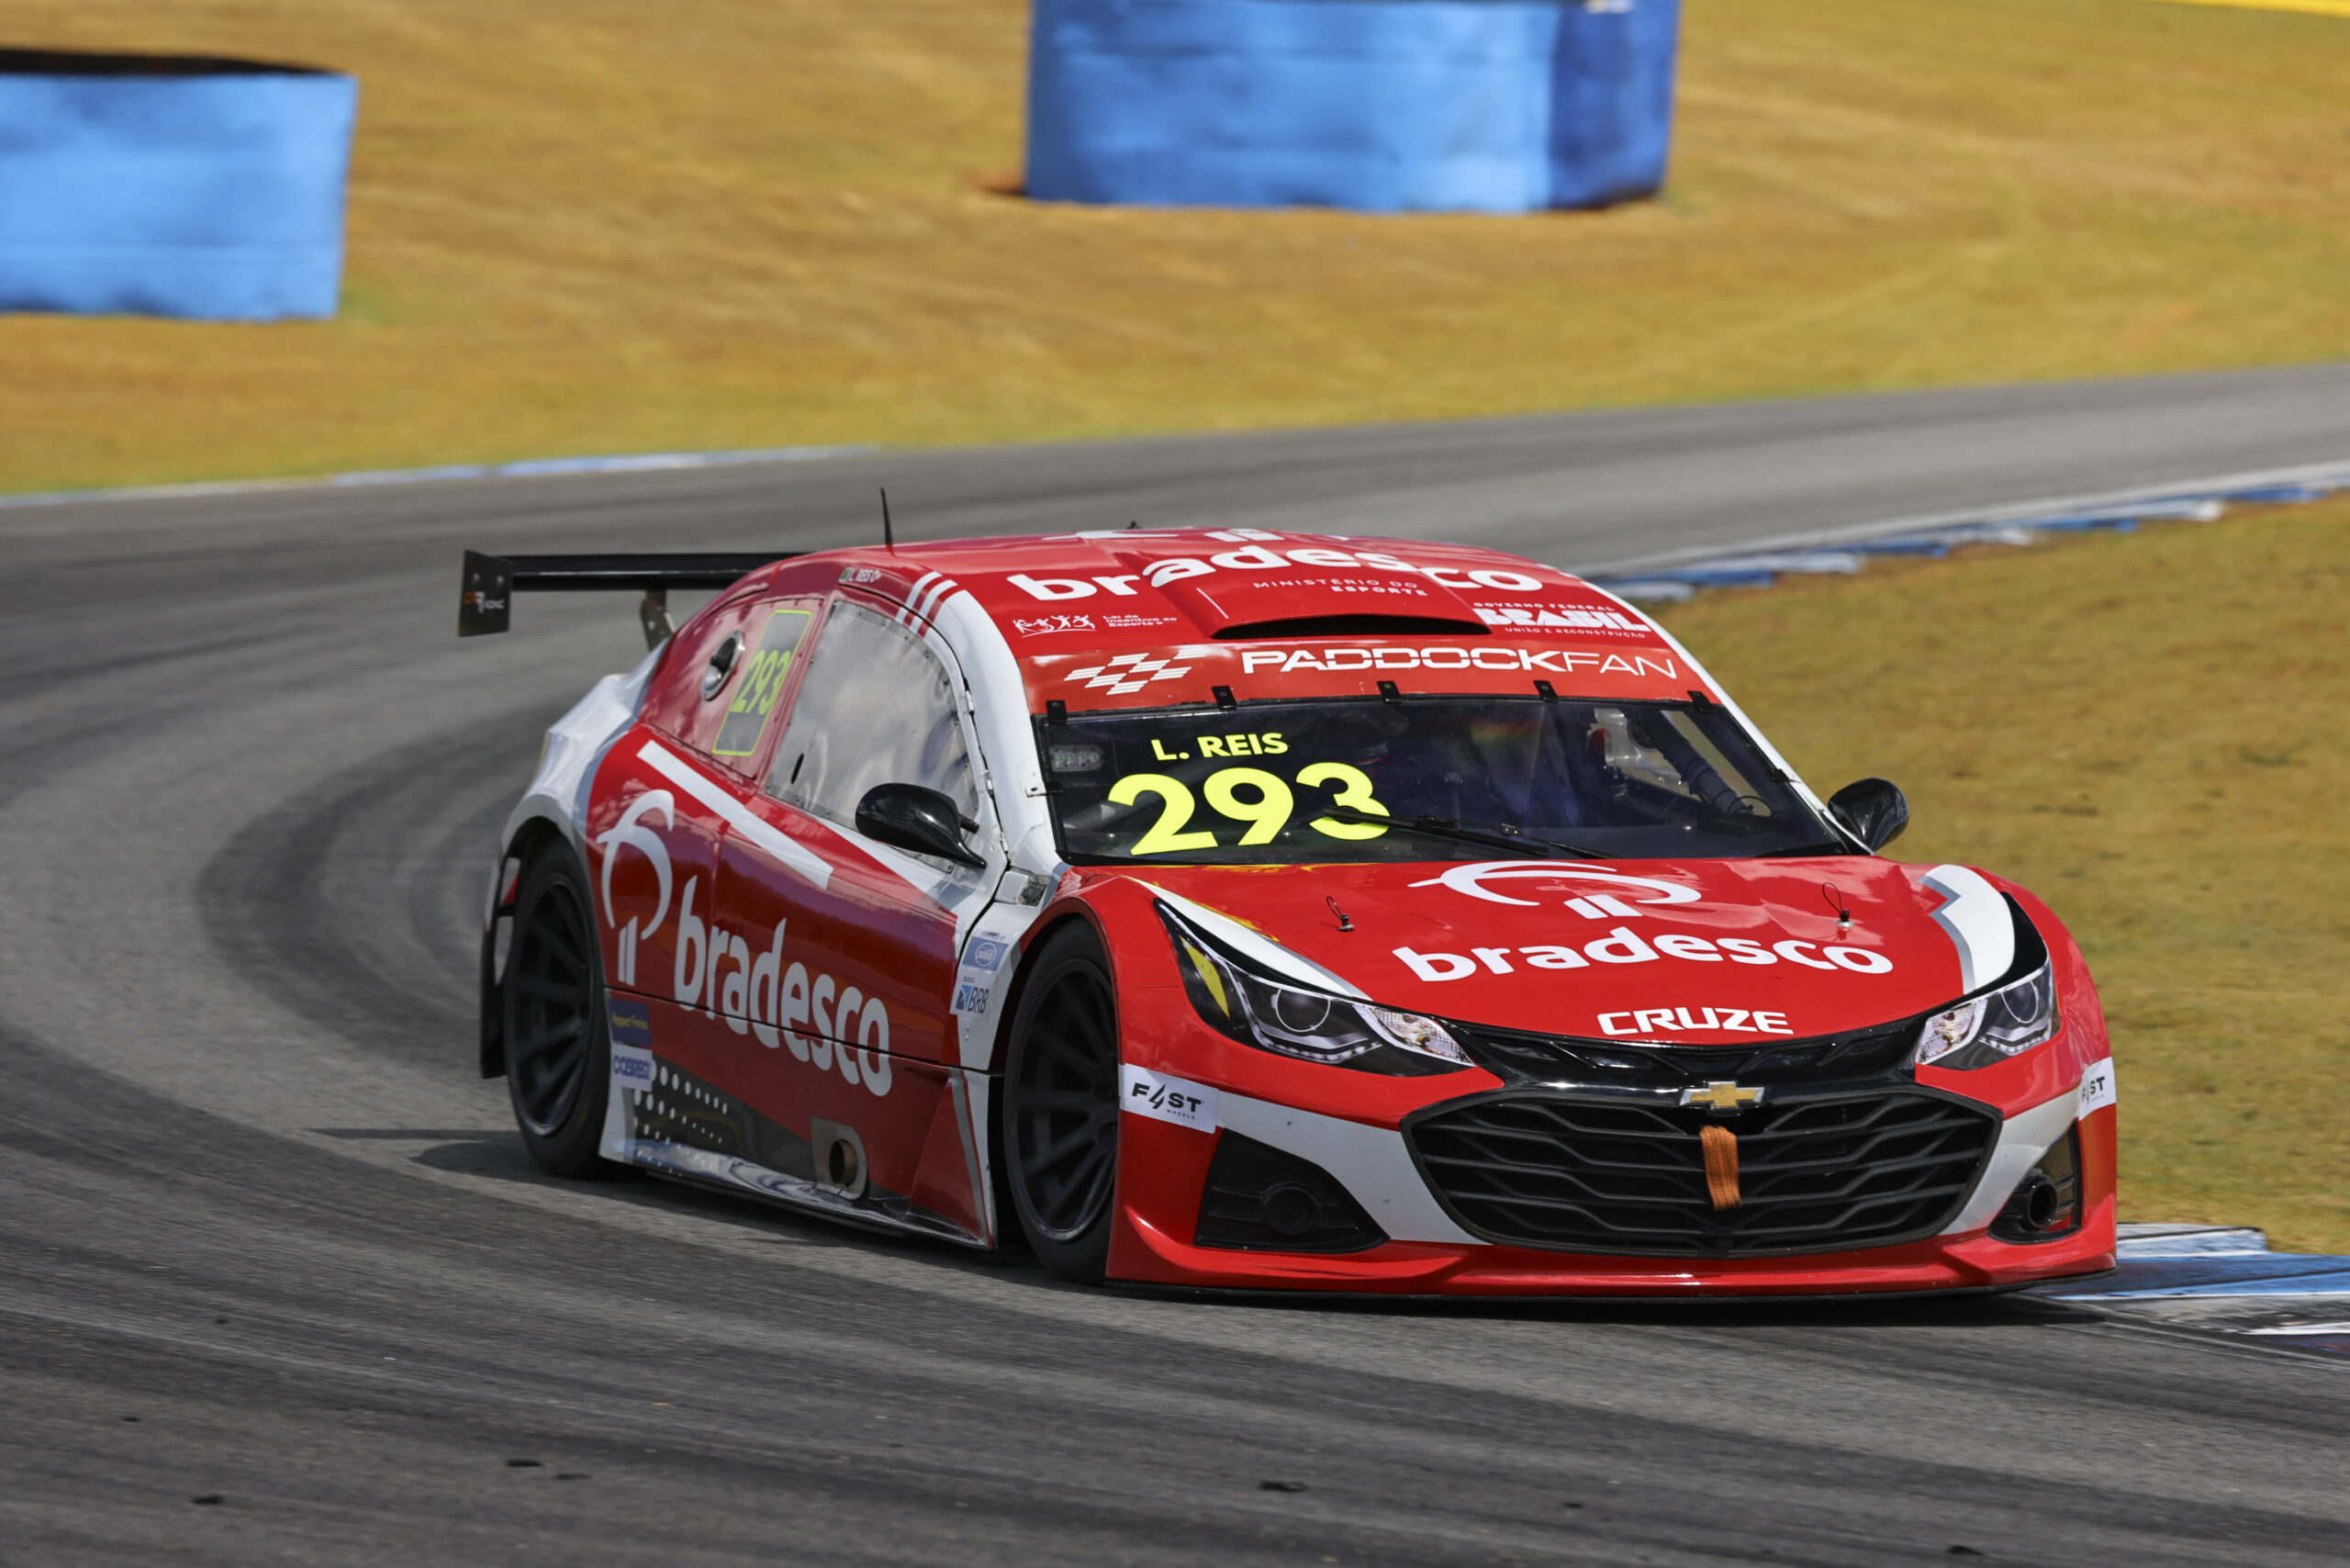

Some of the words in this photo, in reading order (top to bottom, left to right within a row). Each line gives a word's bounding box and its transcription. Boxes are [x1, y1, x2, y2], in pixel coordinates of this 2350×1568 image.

[1007, 545, 1543, 600] bradesco
[1253, 577, 1380, 589] MINISTÉRIO
[1392, 580, 1418, 589] DO
[1330, 586, 1428, 597] ESPORTE
[1472, 608, 1652, 633] BRASIL
[1549, 603, 1615, 612] FEDERAL
[729, 648, 792, 716] 293
[1150, 739, 1190, 761] L.
[1197, 733, 1289, 758] REIS
[1107, 761, 1391, 856] 293
[1393, 926, 1894, 982] bradesco
[674, 875, 892, 1096] bradesco
[968, 987, 990, 1014] BRB
[1596, 1006, 1795, 1036] CRUZE
[1166, 1108, 1196, 1121] WHEELS
